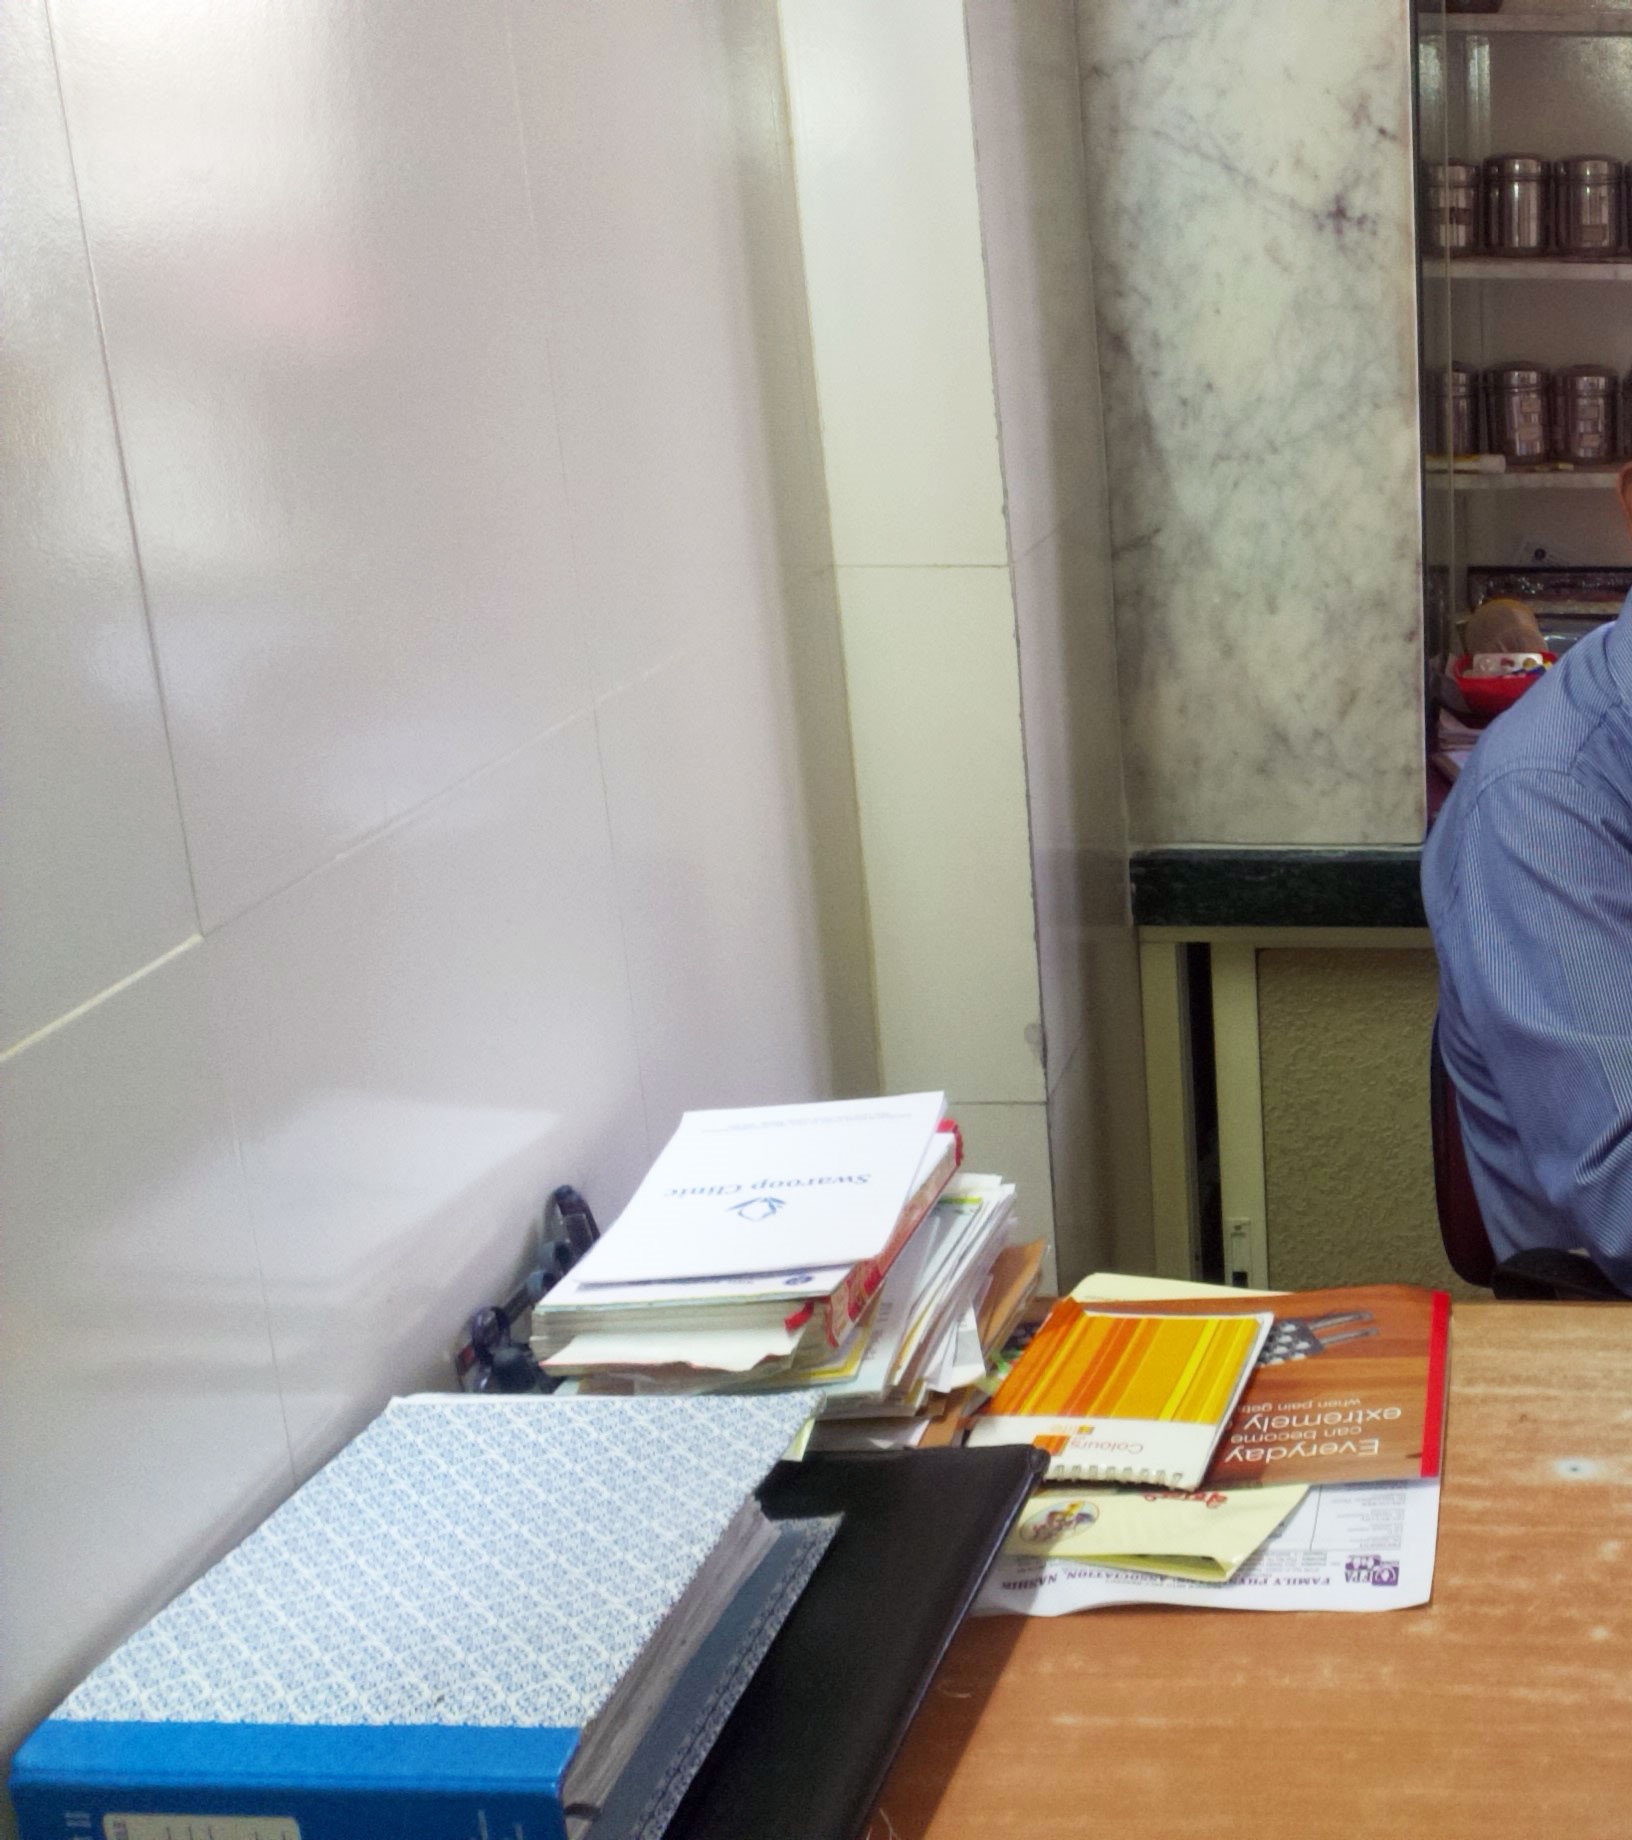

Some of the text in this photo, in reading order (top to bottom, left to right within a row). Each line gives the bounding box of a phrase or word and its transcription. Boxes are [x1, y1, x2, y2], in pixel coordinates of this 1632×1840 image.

[663, 1173, 871, 1199] Swaroop Clinic
[1278, 1400, 1313, 1412] pain
[1318, 1398, 1361, 1409] when
[1243, 1407, 1402, 1433] extremely
[1231, 1426, 1362, 1445] can become
[1071, 1440, 1144, 1455] Colours
[1224, 1438, 1379, 1464] Everyday
[1001, 1573, 1057, 1591] NASHIK
[1273, 1576, 1331, 1587] FAMILY
[1344, 1570, 1370, 1584] FPA
